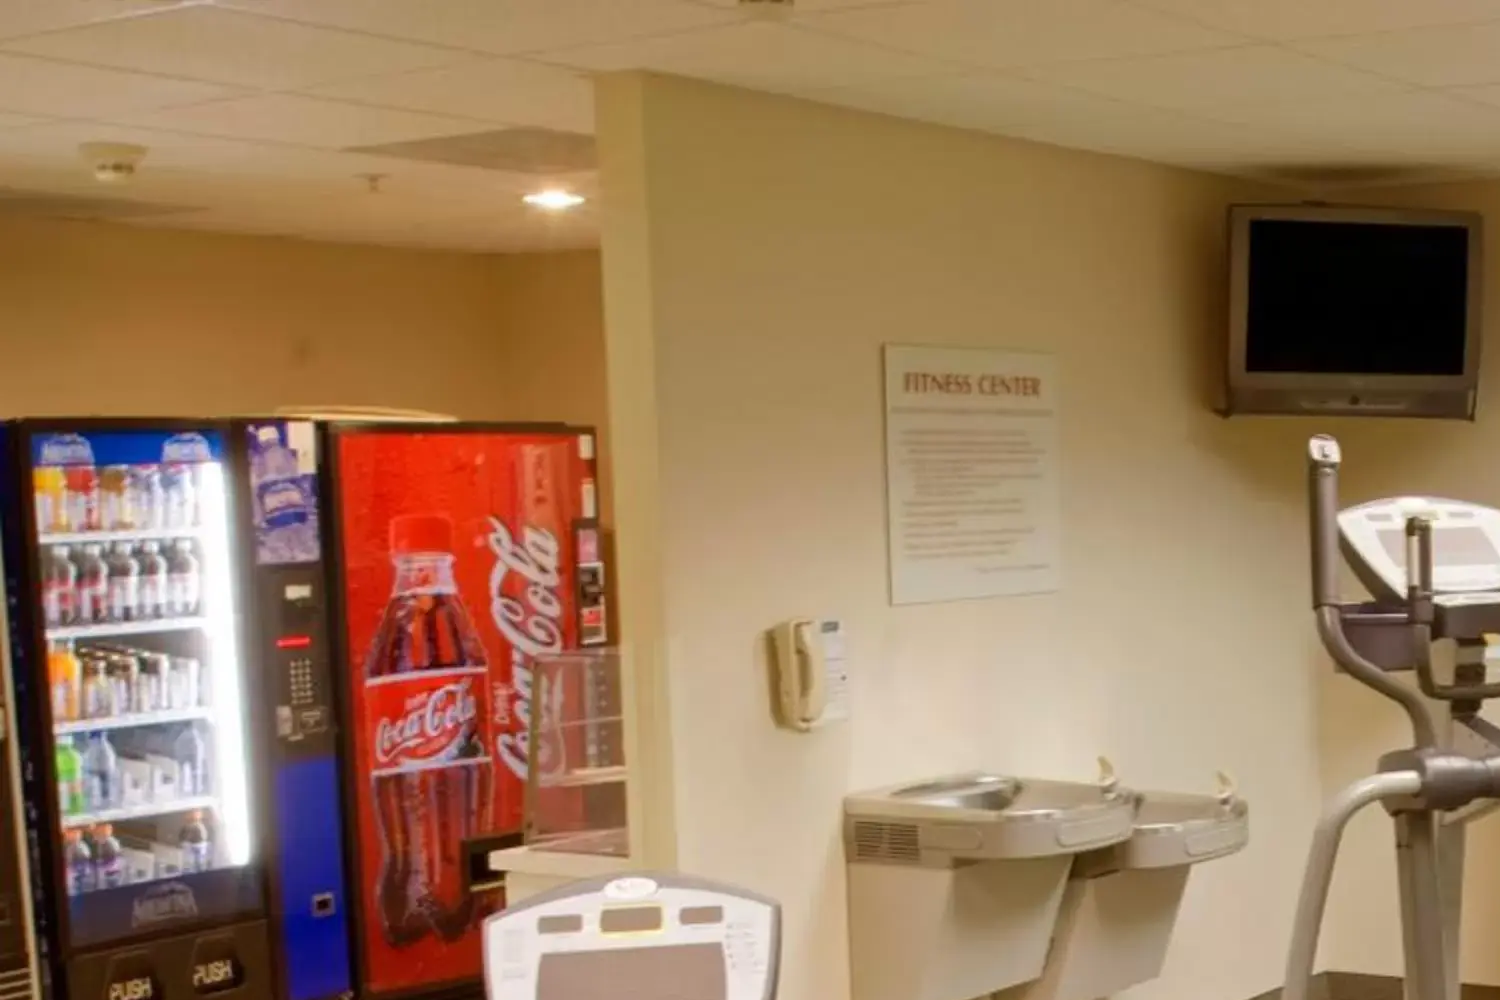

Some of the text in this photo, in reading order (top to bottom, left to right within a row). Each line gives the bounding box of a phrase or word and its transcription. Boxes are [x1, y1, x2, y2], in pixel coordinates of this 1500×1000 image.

[903, 372, 1041, 398] FITNESS CENTER
[192, 959, 234, 987] PUSH
